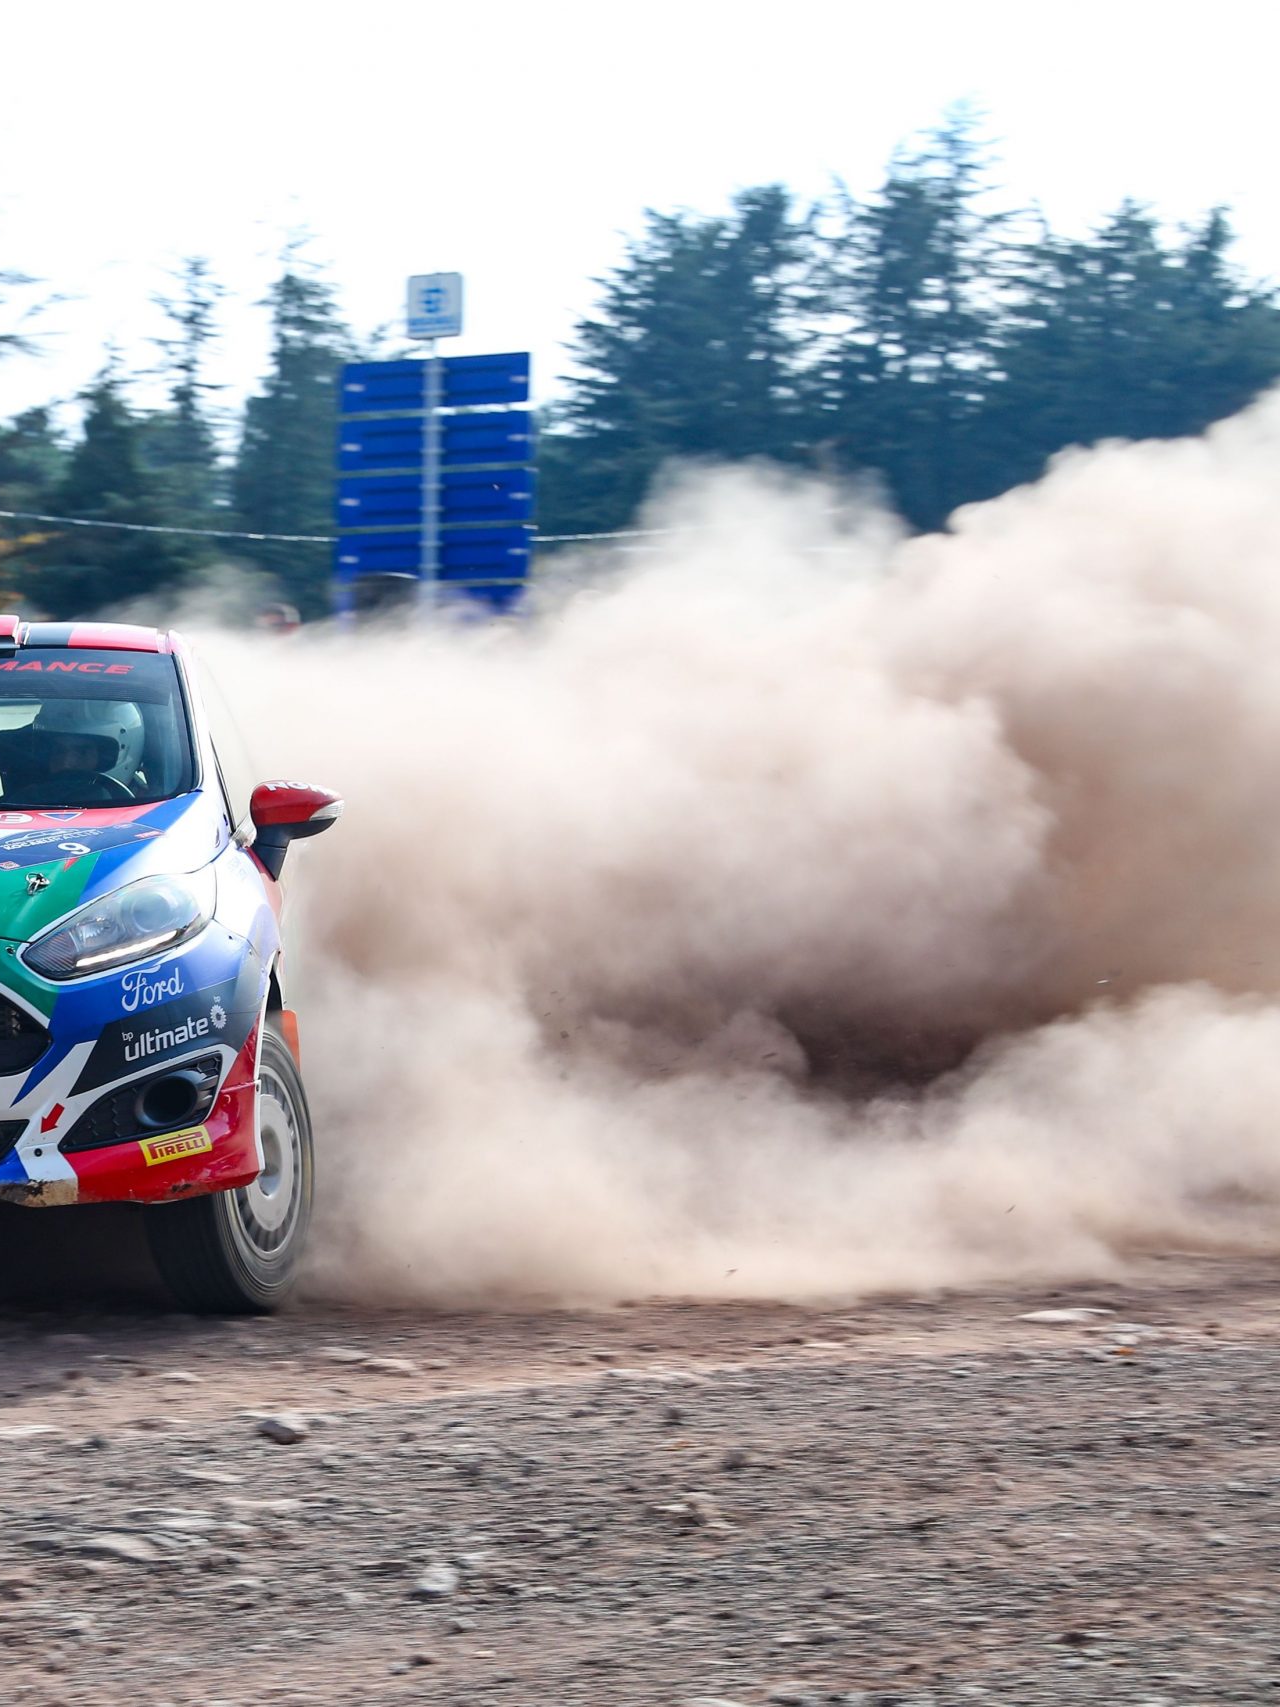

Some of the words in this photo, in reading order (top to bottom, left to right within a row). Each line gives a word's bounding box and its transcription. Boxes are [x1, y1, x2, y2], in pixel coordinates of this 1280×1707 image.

[57, 842, 91, 855] 9
[121, 964, 185, 1012] Ford
[122, 1031, 134, 1041] bp
[124, 1016, 209, 1061] ultimate
[147, 1131, 207, 1160] PIRELLI
